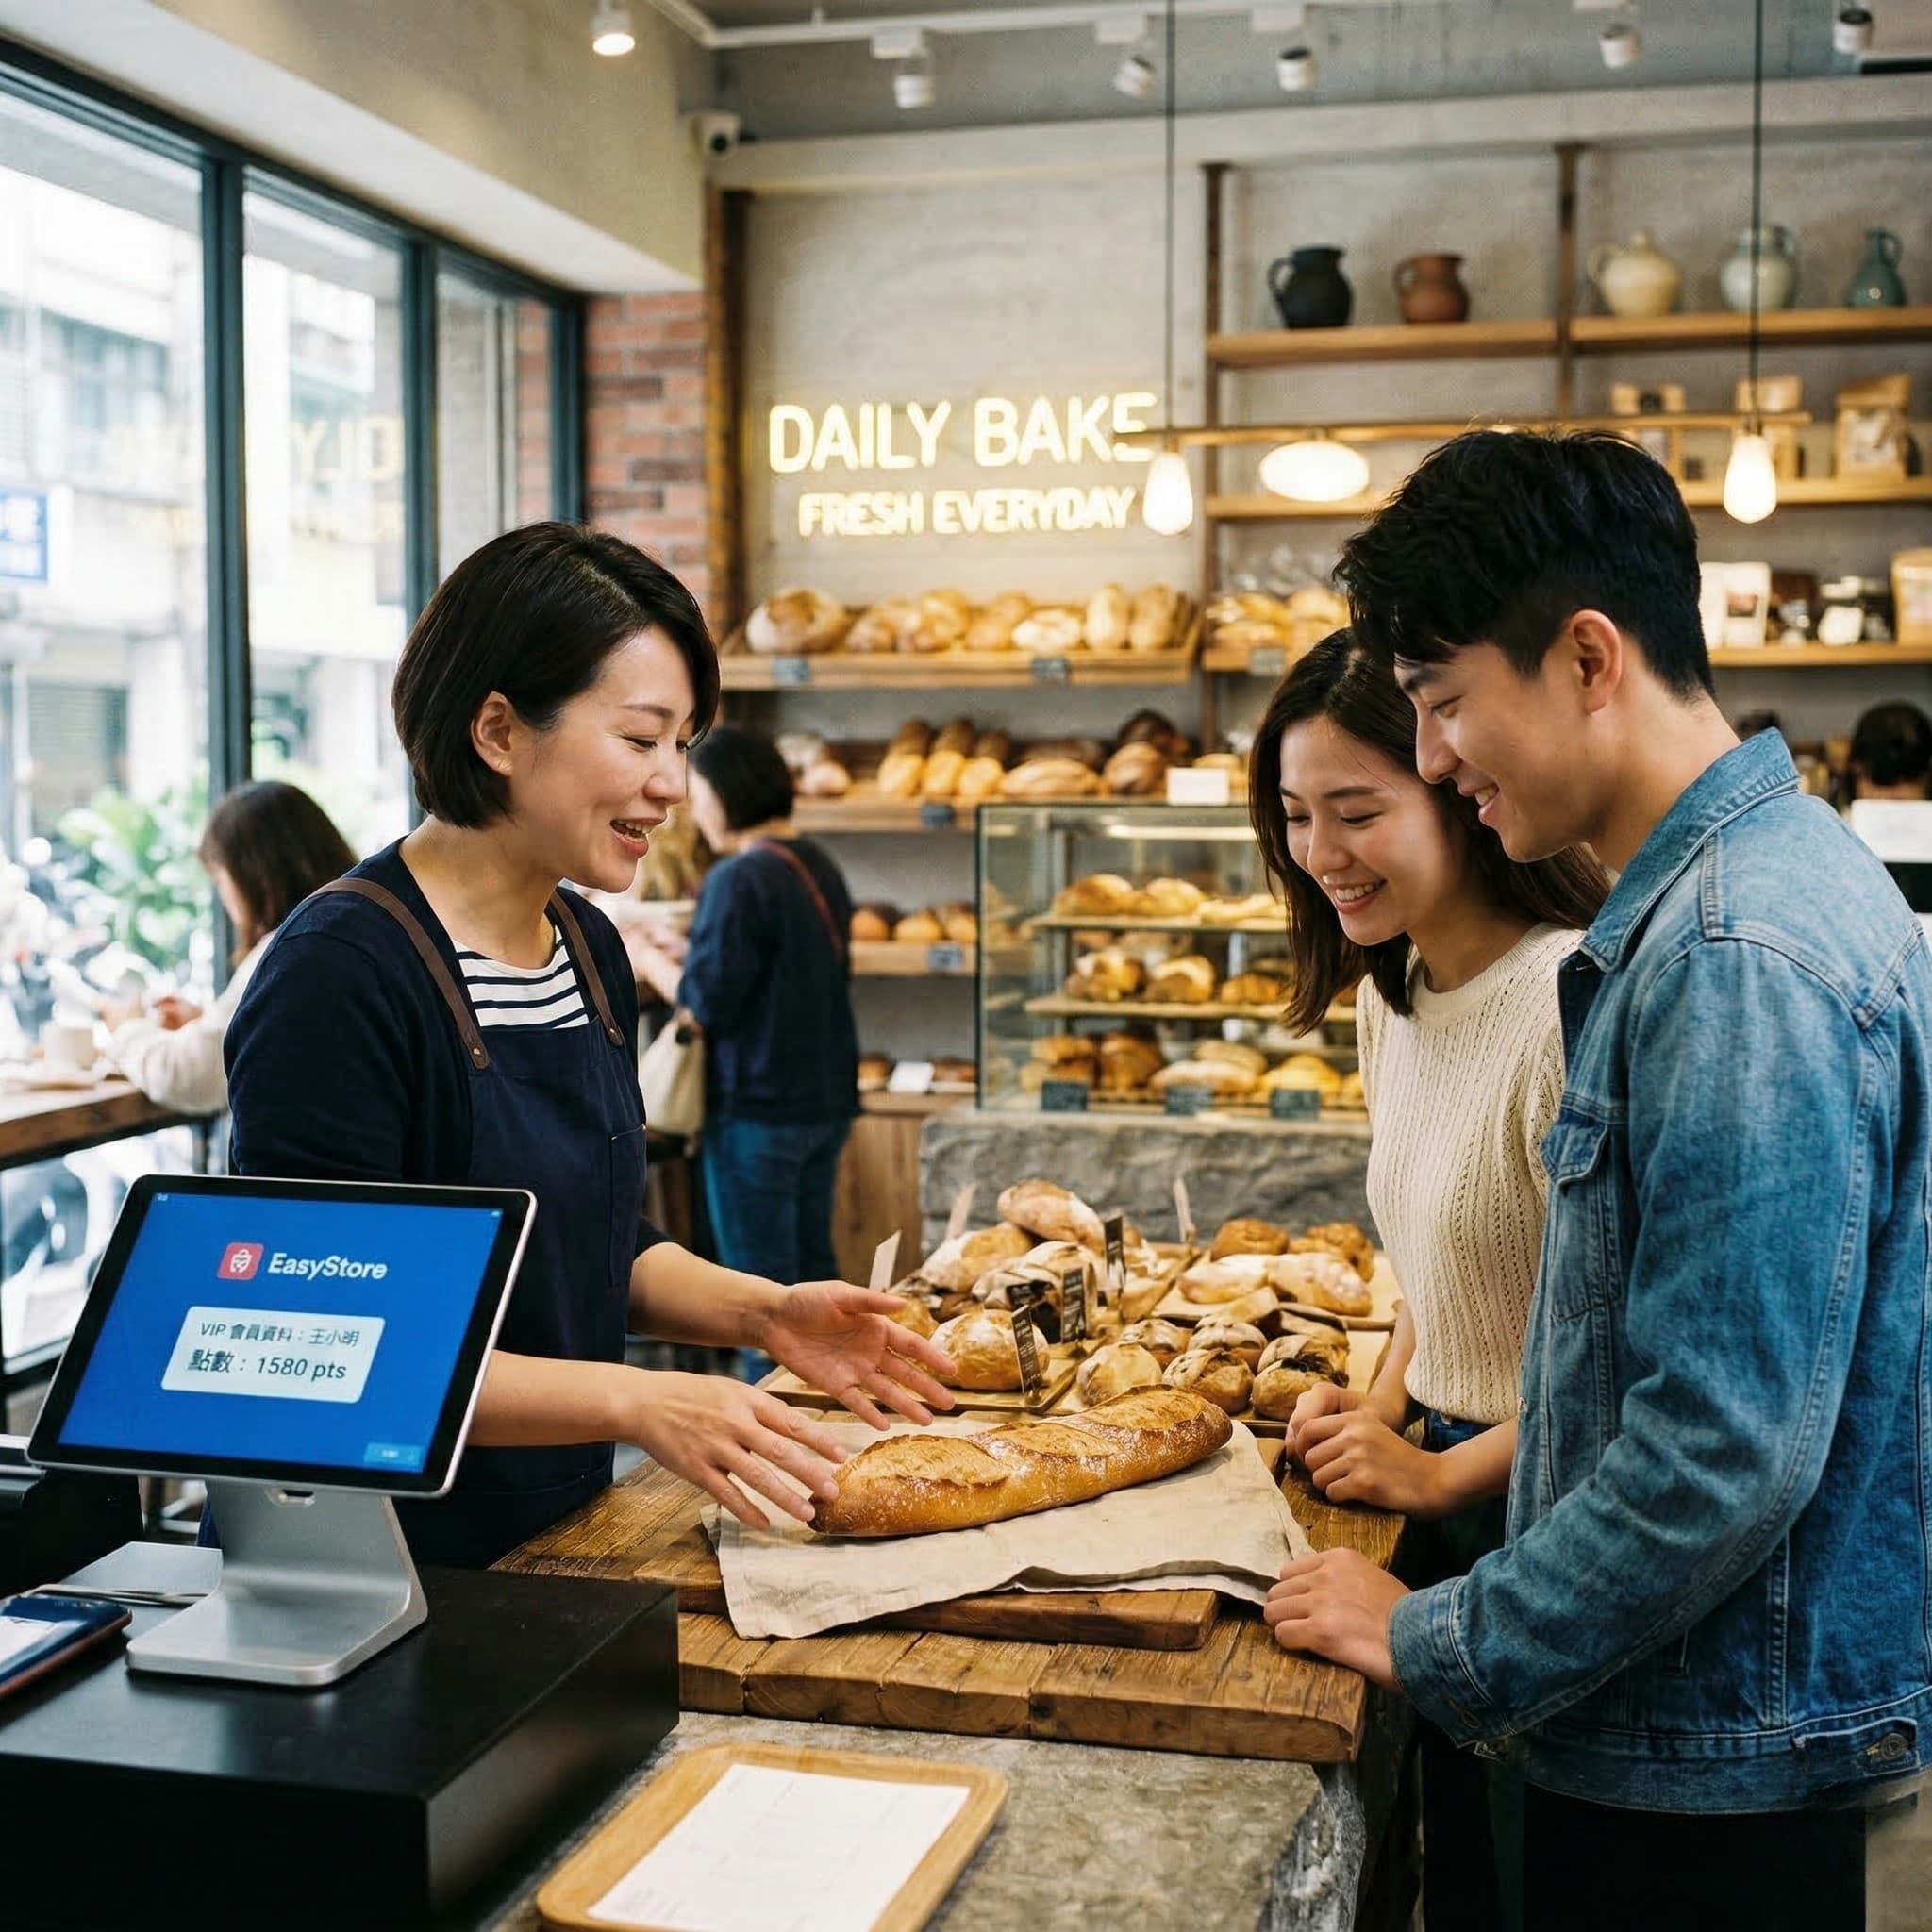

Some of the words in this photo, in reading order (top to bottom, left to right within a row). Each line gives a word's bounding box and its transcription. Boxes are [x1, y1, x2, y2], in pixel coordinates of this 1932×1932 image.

[769, 401, 951, 473] DAILY
[974, 391, 1158, 467] BAKE
[798, 491, 924, 537] FRESH
[932, 486, 1136, 533] EVERYDAY
[268, 1253, 388, 1280] EasyStore
[201, 1323, 226, 1336] VIP
[257, 1357, 308, 1376] 1580
[311, 1362, 347, 1381] pts
